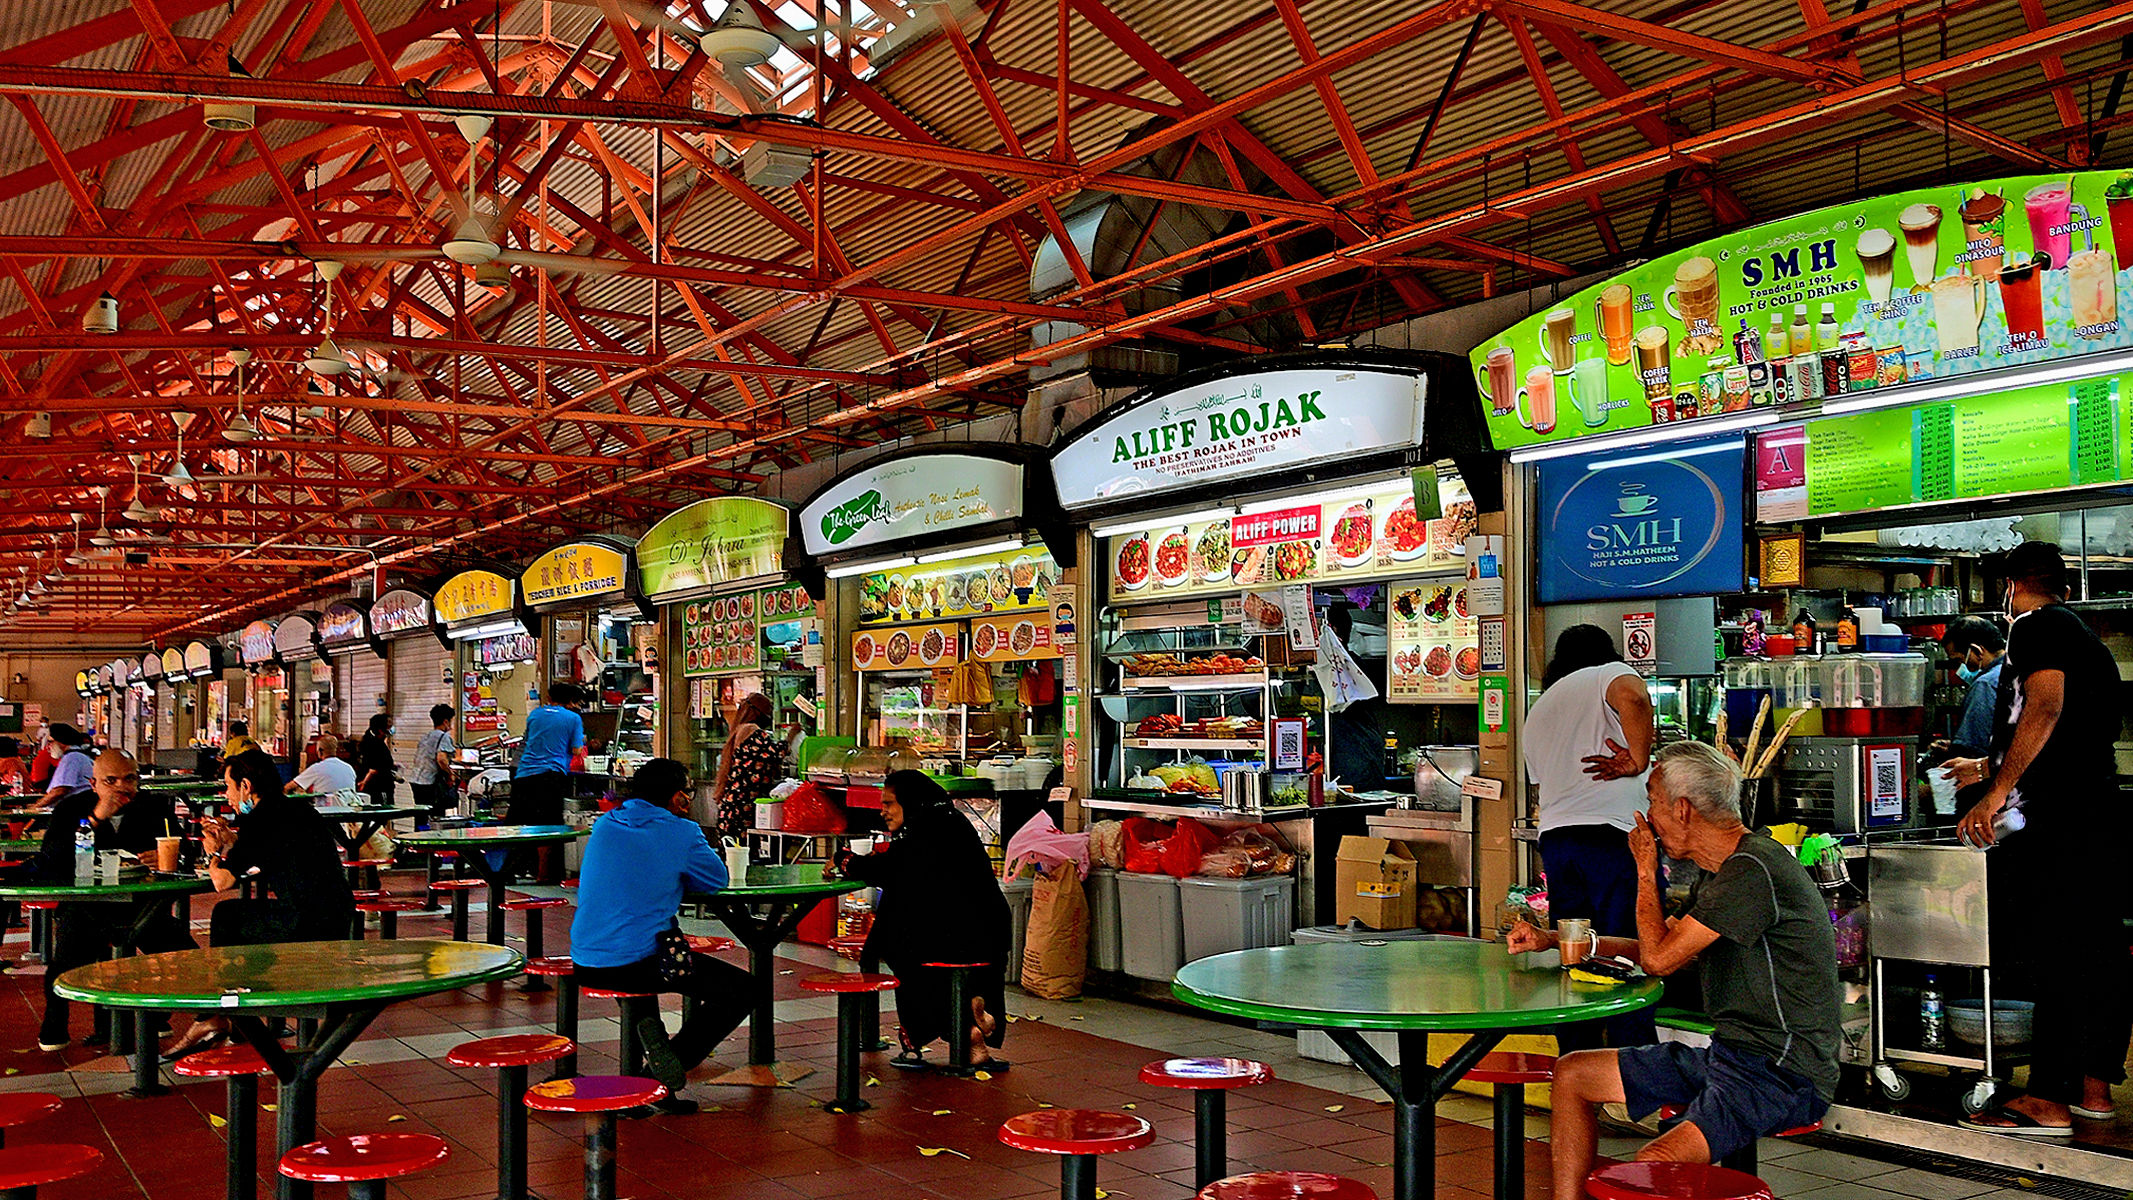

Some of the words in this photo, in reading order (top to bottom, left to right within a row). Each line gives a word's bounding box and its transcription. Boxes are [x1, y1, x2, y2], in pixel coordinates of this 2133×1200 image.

[2049, 216, 2102, 237] BANDUNG
[1966, 238, 1992, 251] MILO
[1954, 245, 2006, 264] DINASOUR
[1750, 281, 1792, 299] Founded
[1794, 279, 1805, 289] in
[1807, 273, 1834, 287] 1965
[1729, 303, 1754, 316] HOT
[1757, 298, 1767, 310] &
[1770, 292, 1804, 308] COLD
[1807, 280, 1860, 298] DRINKS
[1863, 302, 1881, 314] TEH
[1889, 293, 1922, 308] COFFEE
[1693, 318, 1709, 328] TEH
[1879, 306, 1908, 321] CHINO
[2007, 331, 2027, 344] TEH
[2028, 330, 2037, 340] O
[2073, 320, 2120, 338] LONGAN
[1568, 332, 1593, 346] COFFEE
[1997, 344, 2016, 356] ICE
[2017, 338, 2050, 354] LIMAU
[1944, 345, 1981, 361] BARLEY
[1643, 366, 1671, 379] COFFEE
[1647, 375, 1669, 386] TARIK
[1112, 419, 1197, 463] ALIFF
[1208, 391, 1326, 441] ROJAK
[1133, 457, 1156, 471] THE
[1160, 450, 1190, 466] BEST
[1194, 442, 1237, 458] ROJAK
[1241, 437, 1256, 449] IN
[1259, 427, 1302, 444] TOWN
[1404, 449, 1422, 464] 101
[1155, 465, 1166, 475] NO
[1166, 454, 1223, 472] PRESERVATIVES
[1225, 452, 1235, 460] NO
[1236, 444, 1276, 458] ADDITIVES
[1766, 446, 1793, 475] A
[1419, 479, 1431, 505] B
[845, 509, 869, 527] Green
[871, 500, 892, 525] Leaf
[1235, 521, 1268, 541] ALIFF
[1272, 514, 1318, 537] POWER
[1586, 517, 1683, 551] SMH
[1589, 560, 1607, 569] HOT
[1609, 559, 1616, 567] &
[1618, 556, 1642, 566] COLD
[1644, 554, 1680, 565] DRINKS
[1593, 551, 1613, 560] HAJI
[527, 588, 555, 601] TEOCHEW
[556, 584, 572, 596] RICE
[580, 576, 617, 592] PORRIDGE
